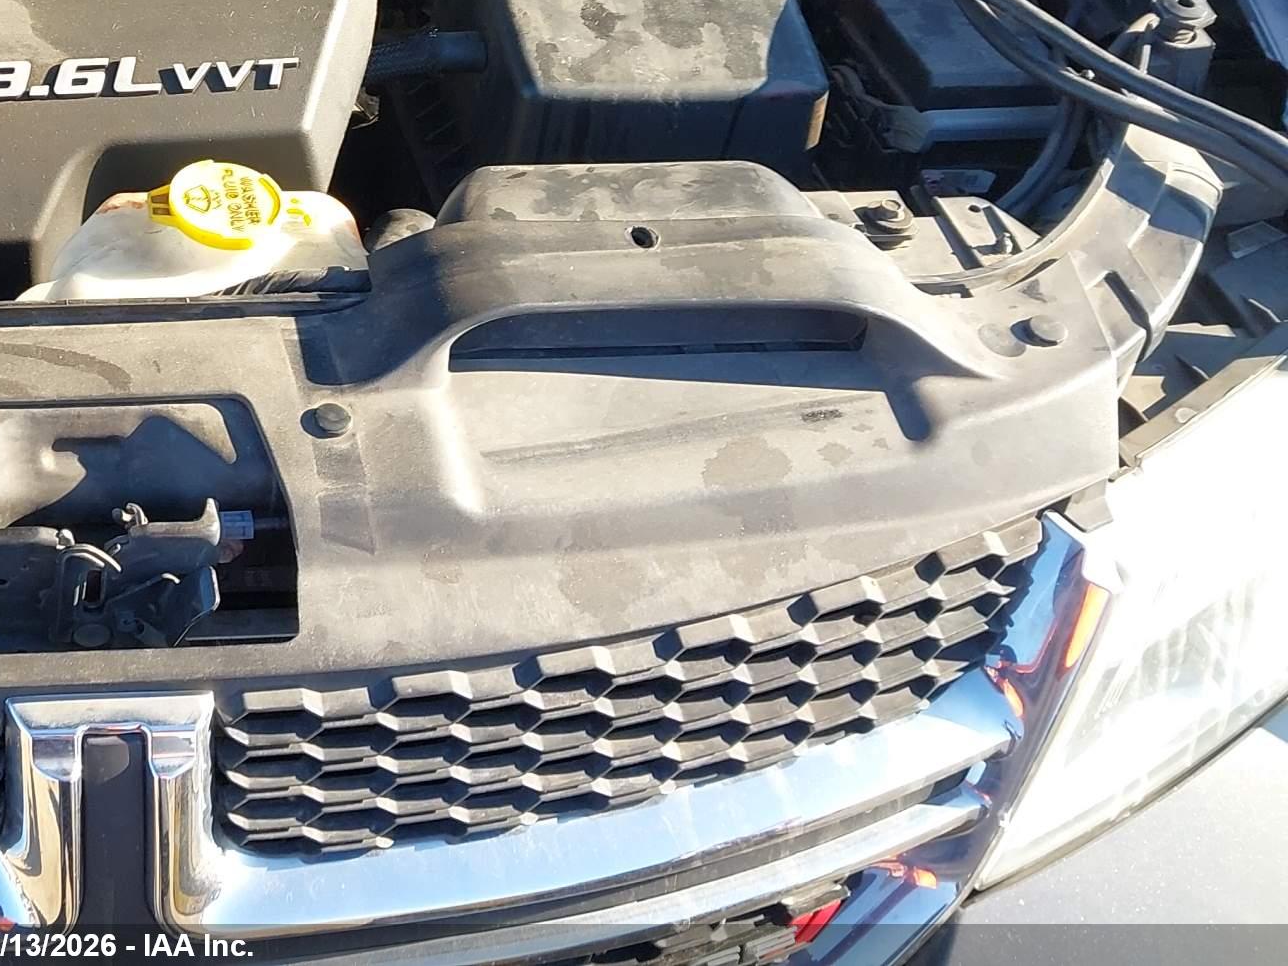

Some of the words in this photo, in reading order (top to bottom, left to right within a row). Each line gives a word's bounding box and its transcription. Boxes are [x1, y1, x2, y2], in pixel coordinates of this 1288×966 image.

[163, 57, 300, 94] VVT
[222, 168, 240, 200] FLUID
[239, 176, 261, 225] WASHER
[227, 202, 246, 232] ONLY
